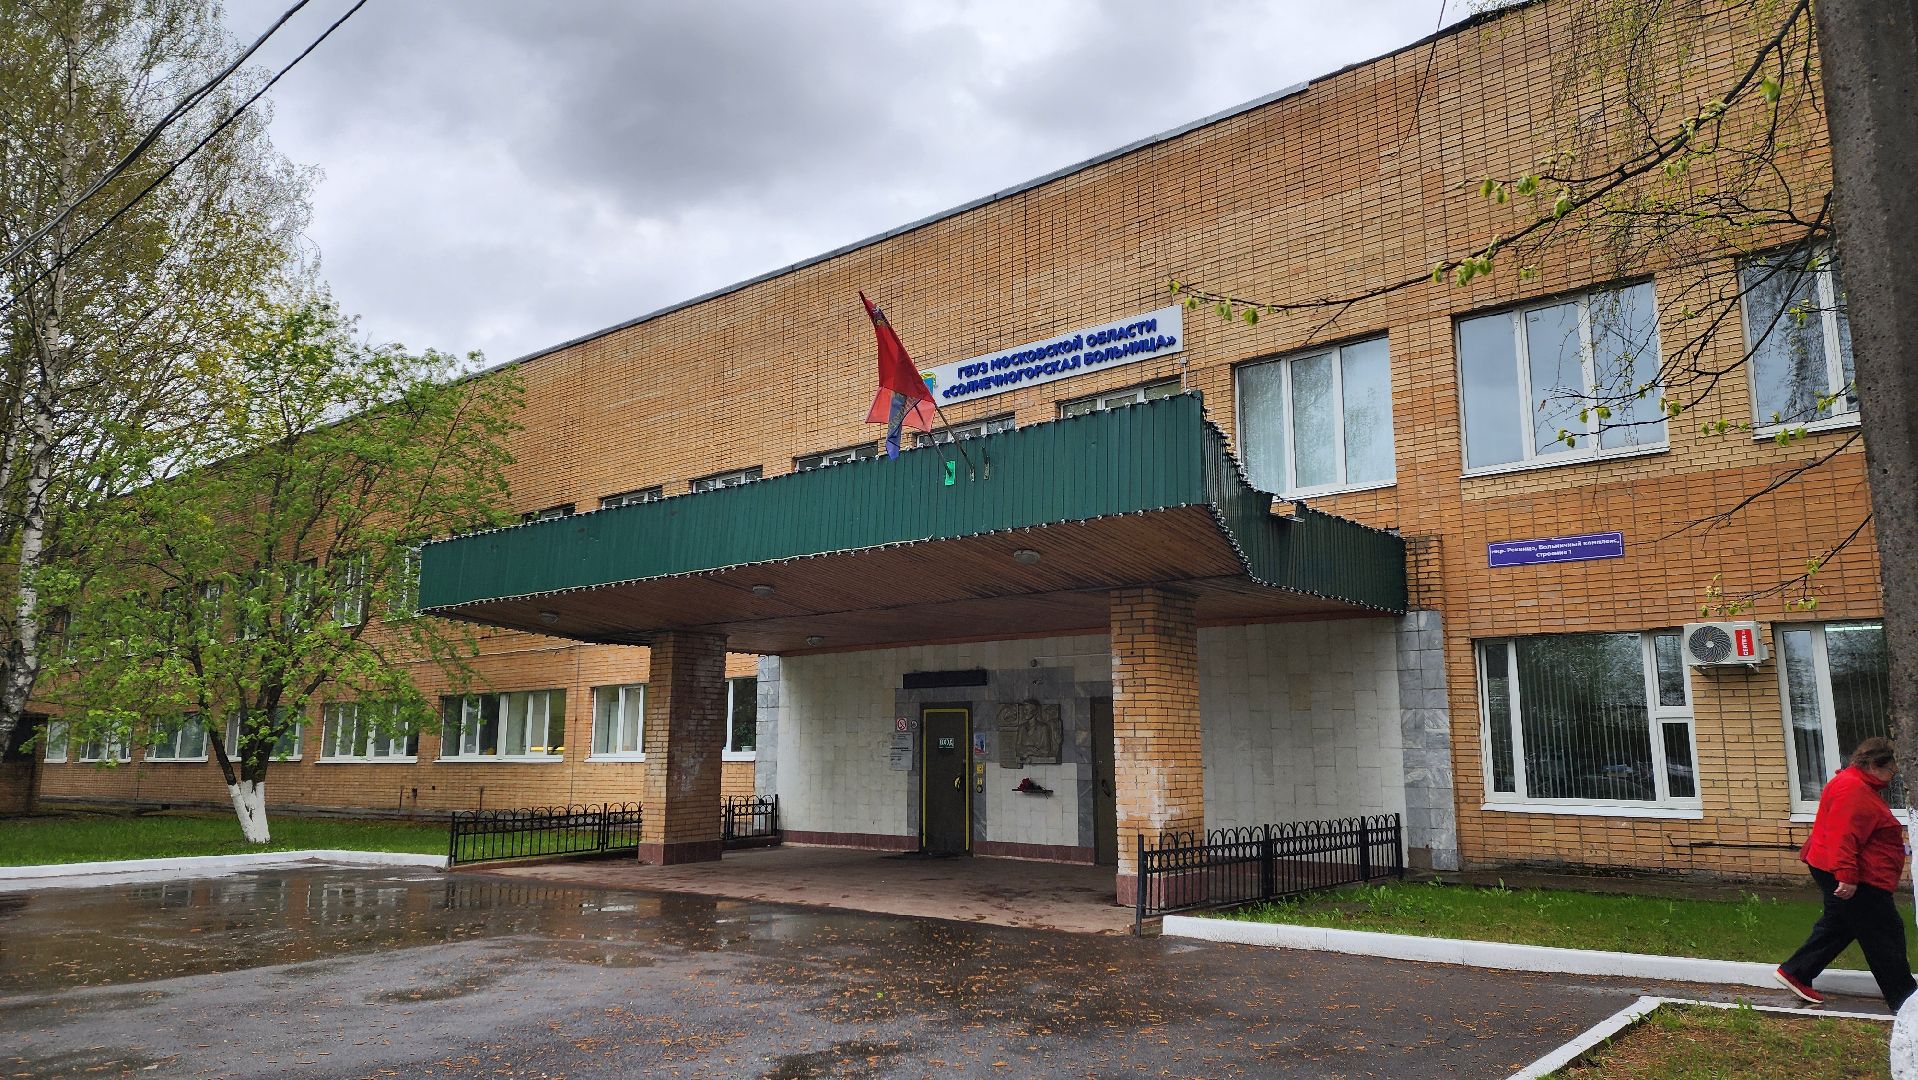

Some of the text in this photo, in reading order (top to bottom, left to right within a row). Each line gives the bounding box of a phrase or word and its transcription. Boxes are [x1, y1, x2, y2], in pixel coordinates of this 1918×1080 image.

[942, 334, 1177, 399] «СОЛНЕЧНОГОРСКАЯ БОЛЬНИЦА»
[957, 318, 1158, 380] ГБУЗ МОСКОВСКОЙ ОБЛАСТИ
[1536, 550, 1567, 558] строение
[1538, 541, 1582, 550] Больничный
